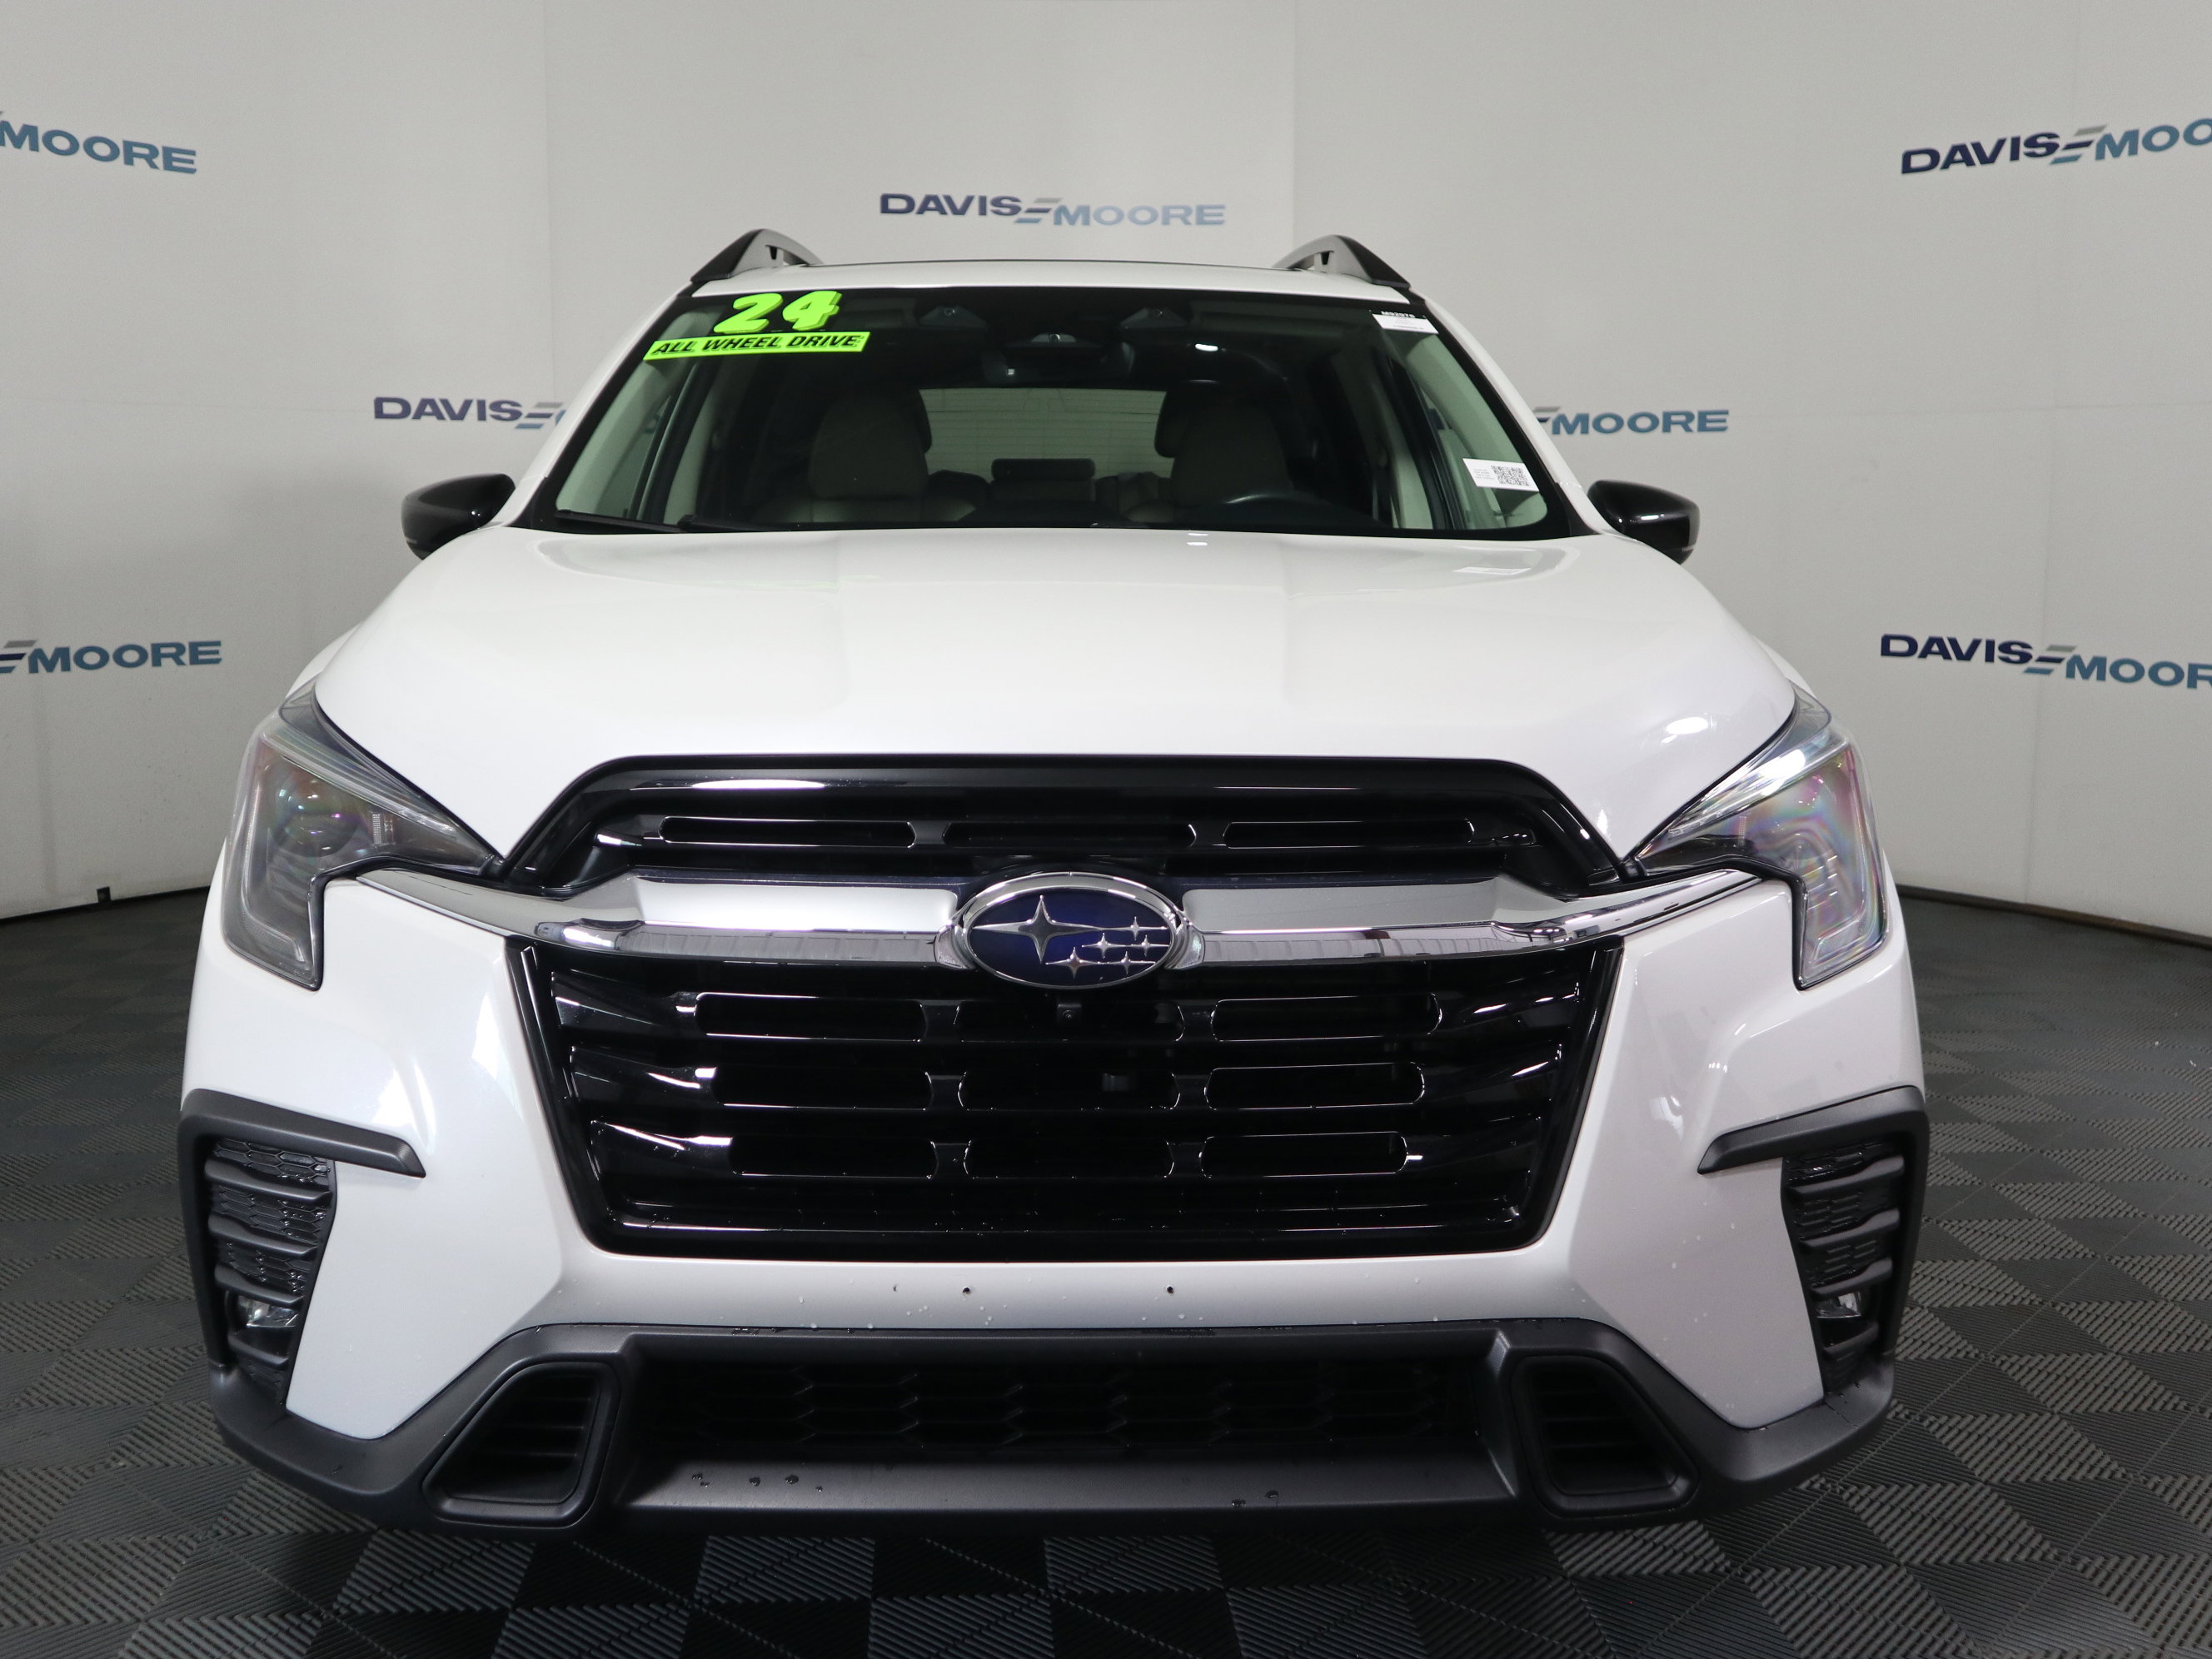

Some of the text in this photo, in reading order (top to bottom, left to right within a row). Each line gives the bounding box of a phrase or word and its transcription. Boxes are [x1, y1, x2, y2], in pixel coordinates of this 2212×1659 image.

[0, 120, 197, 174] MOORE
[1901, 132, 2060, 174] DAVIS
[880, 192, 1226, 226] DAVIS MOORE
[713, 290, 842, 333] 24
[651, 334, 862, 355] ALL WHEEL DRIVE
[374, 396, 523, 421] DAVIS
[1552, 410, 1729, 435] MOORE
[27, 640, 222, 674] MOORE
[1881, 634, 2033, 664] DAVIS
